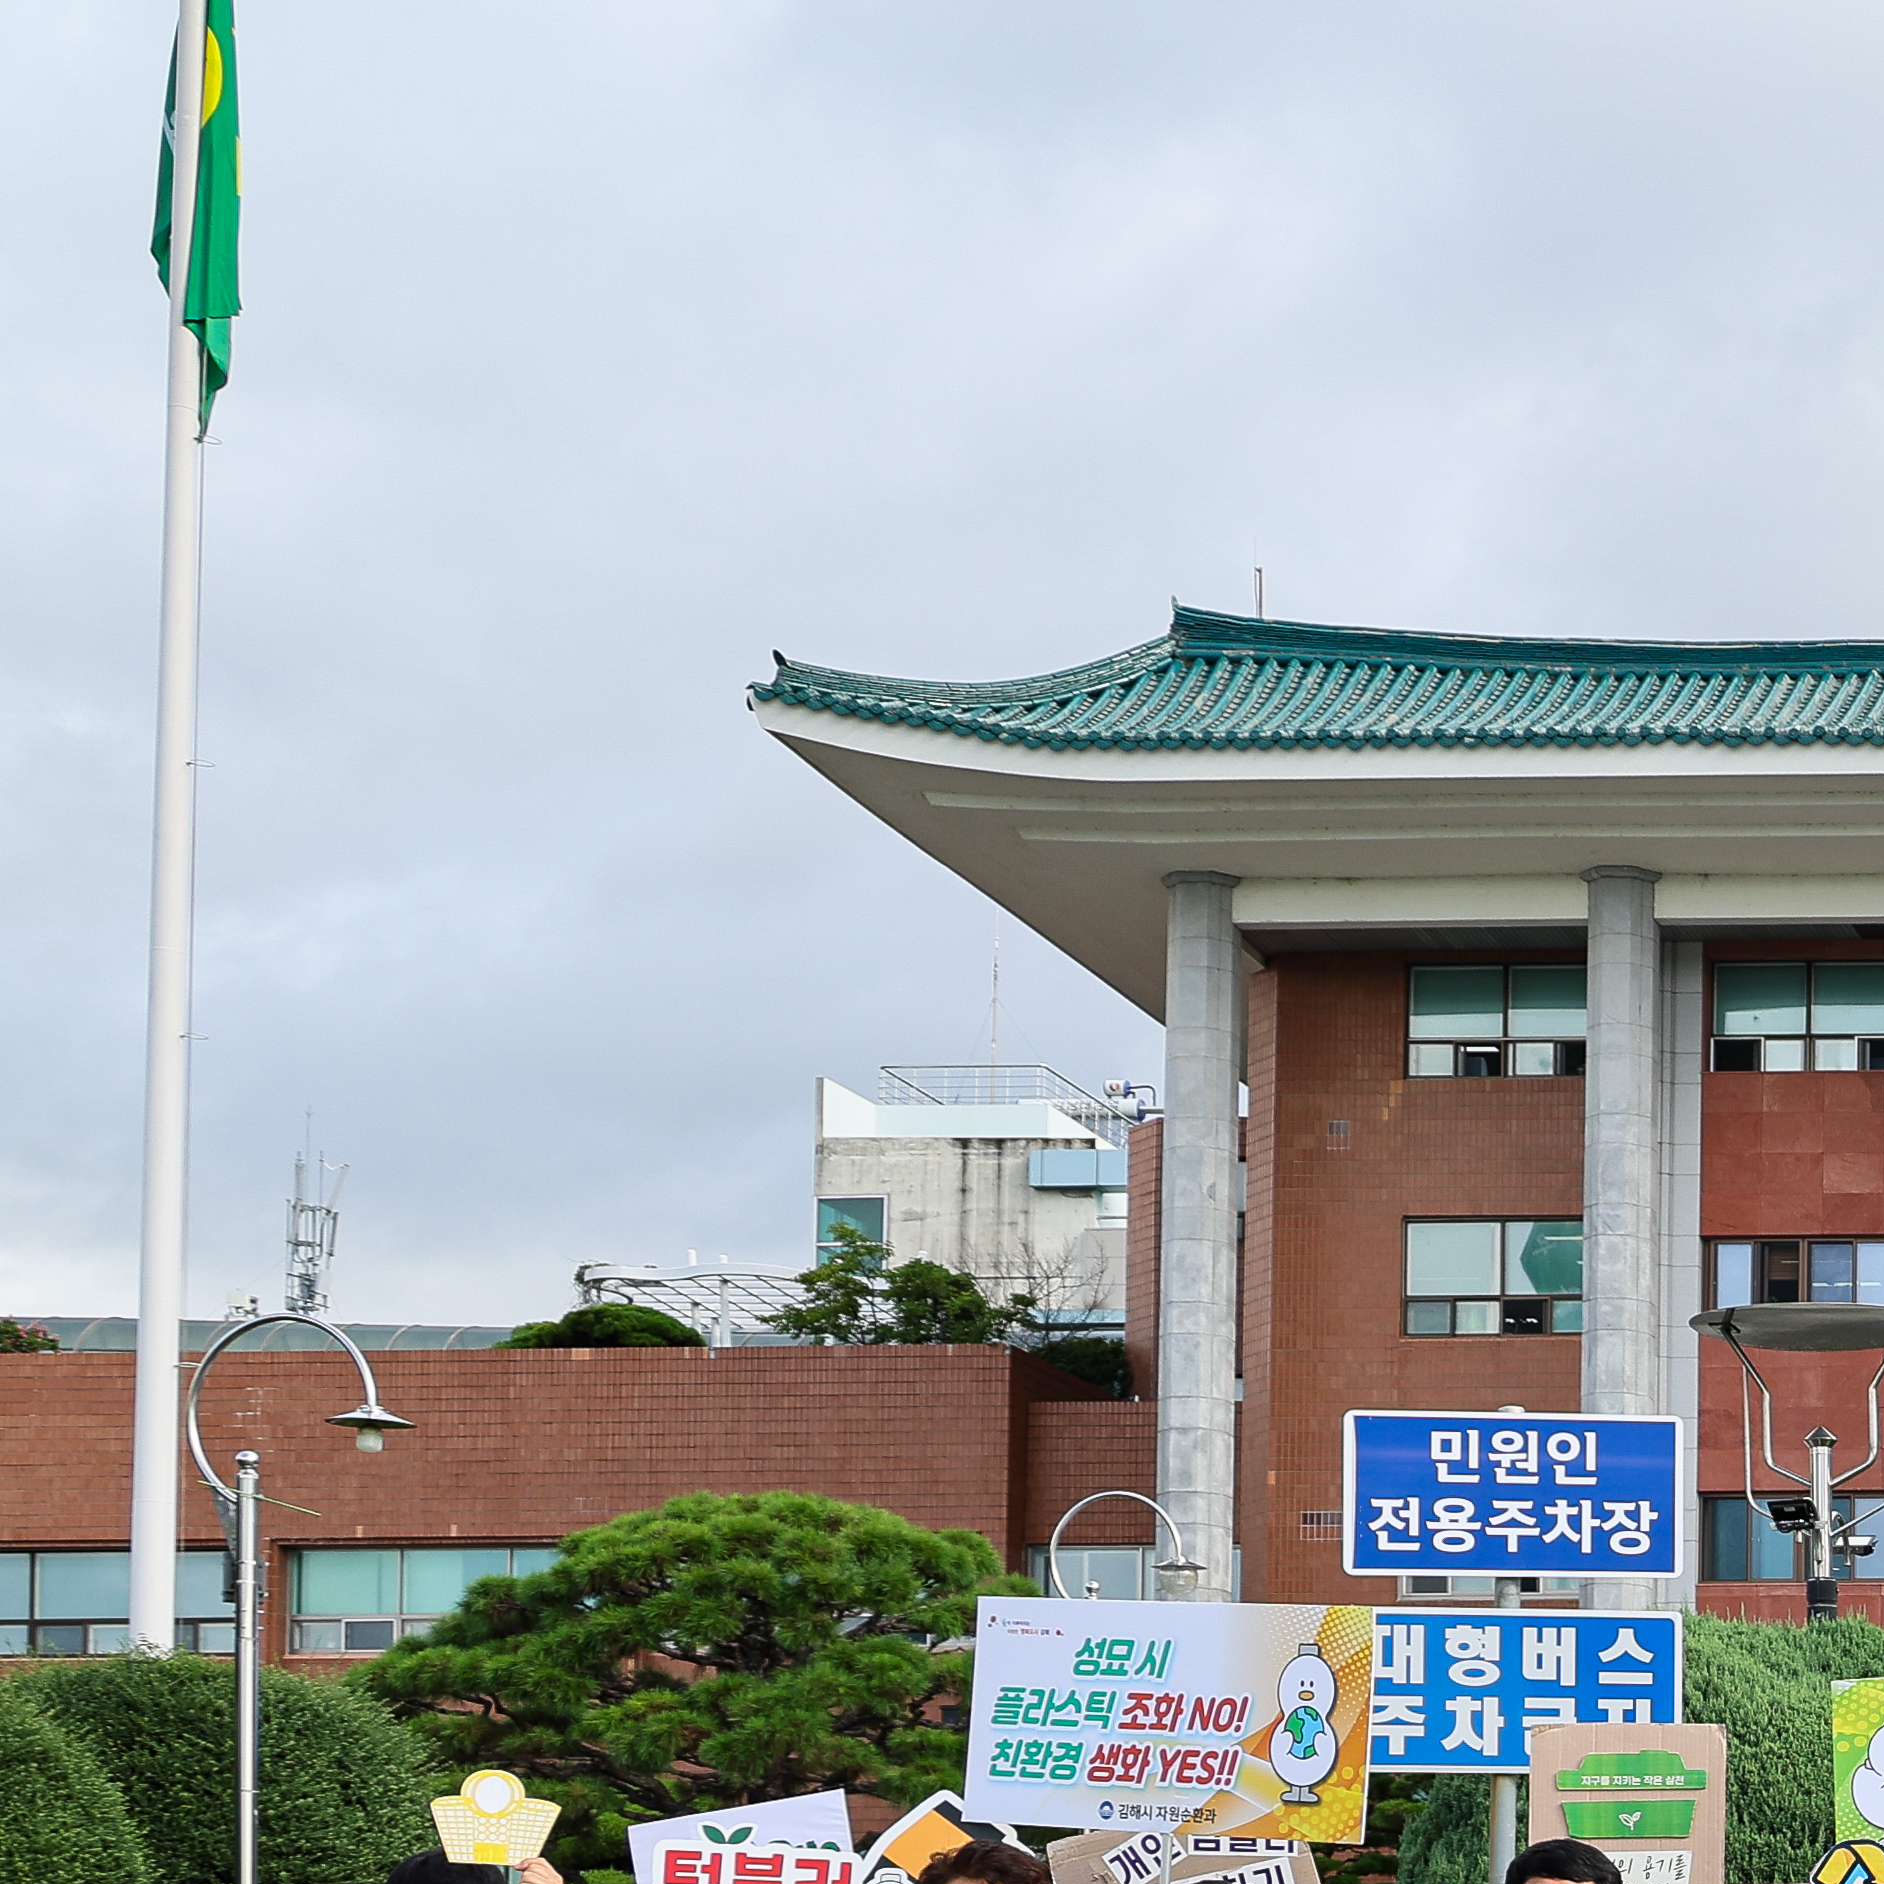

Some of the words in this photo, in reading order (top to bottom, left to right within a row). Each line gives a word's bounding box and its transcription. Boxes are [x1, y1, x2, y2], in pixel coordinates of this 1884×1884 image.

[1430, 1429, 1598, 1485] 민원인
[1367, 1496, 1659, 1555] 전용주차장
[1072, 1637, 1135, 1678] 성묘
[1133, 1639, 1172, 1679] 시
[1375, 1624, 1655, 1687] 대형버스
[990, 1686, 1117, 1730] 플라스틱
[1117, 1692, 1184, 1733] 조화
[1187, 1696, 1249, 1733] NO!
[988, 1739, 1084, 1781] 친환경
[1086, 1743, 1151, 1784] 생화
[1157, 1748, 1240, 1786] YES!!
[1581, 1774, 1610, 1786] 지구를
[1612, 1774, 1642, 1786] 지키는
[1643, 1775, 1663, 1786] 작은
[1665, 1775, 1685, 1786] 실천
[1118, 1803, 1153, 1821] 김해시
[1155, 1807, 1217, 1824] 자원순환과
[1643, 1854, 1689, 1881] 용기를
